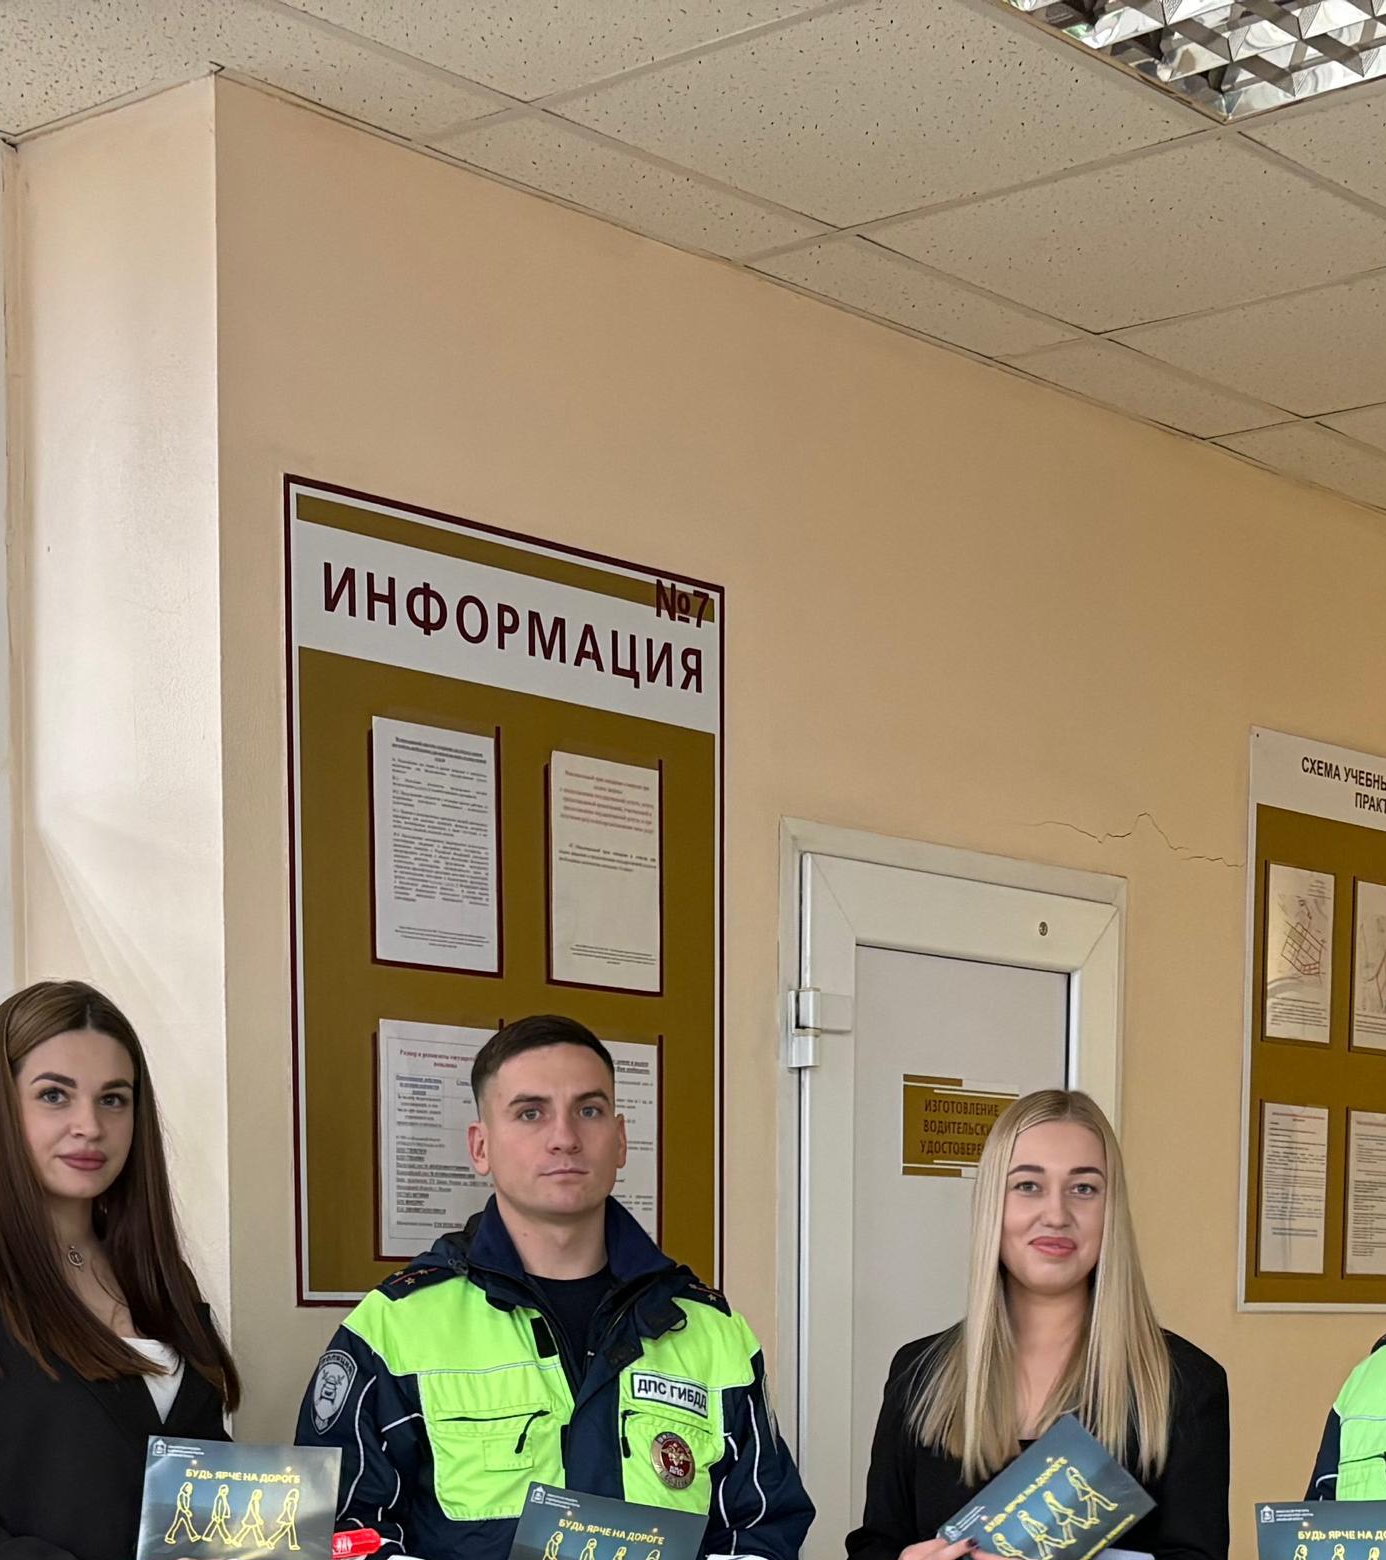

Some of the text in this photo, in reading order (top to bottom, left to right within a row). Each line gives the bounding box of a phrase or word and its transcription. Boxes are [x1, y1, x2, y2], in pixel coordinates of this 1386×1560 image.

[655, 579, 711, 629] №7
[323, 560, 704, 694] ИНФОРМАЦИЯ
[1301, 755, 1342, 781] СХЕМА
[924, 1098, 1000, 1118] ИЗГОТОВЛЕНИЕ
[919, 1139, 984, 1156] УДОСТОВЕРЕ
[637, 1377, 709, 1413] ДПС ГИБДД
[185, 1467, 301, 1485] БУДЬ ЯРЧЕ НА ДОРОГЕ
[558, 1517, 665, 1546] БУДЬ ЯРЧЕ НА ДОРОГЕ
[1297, 1530, 1326, 1541] БУДЬ
[1328, 1530, 1356, 1540] ЯРЧЕ
[1357, 1530, 1374, 1540] НА
